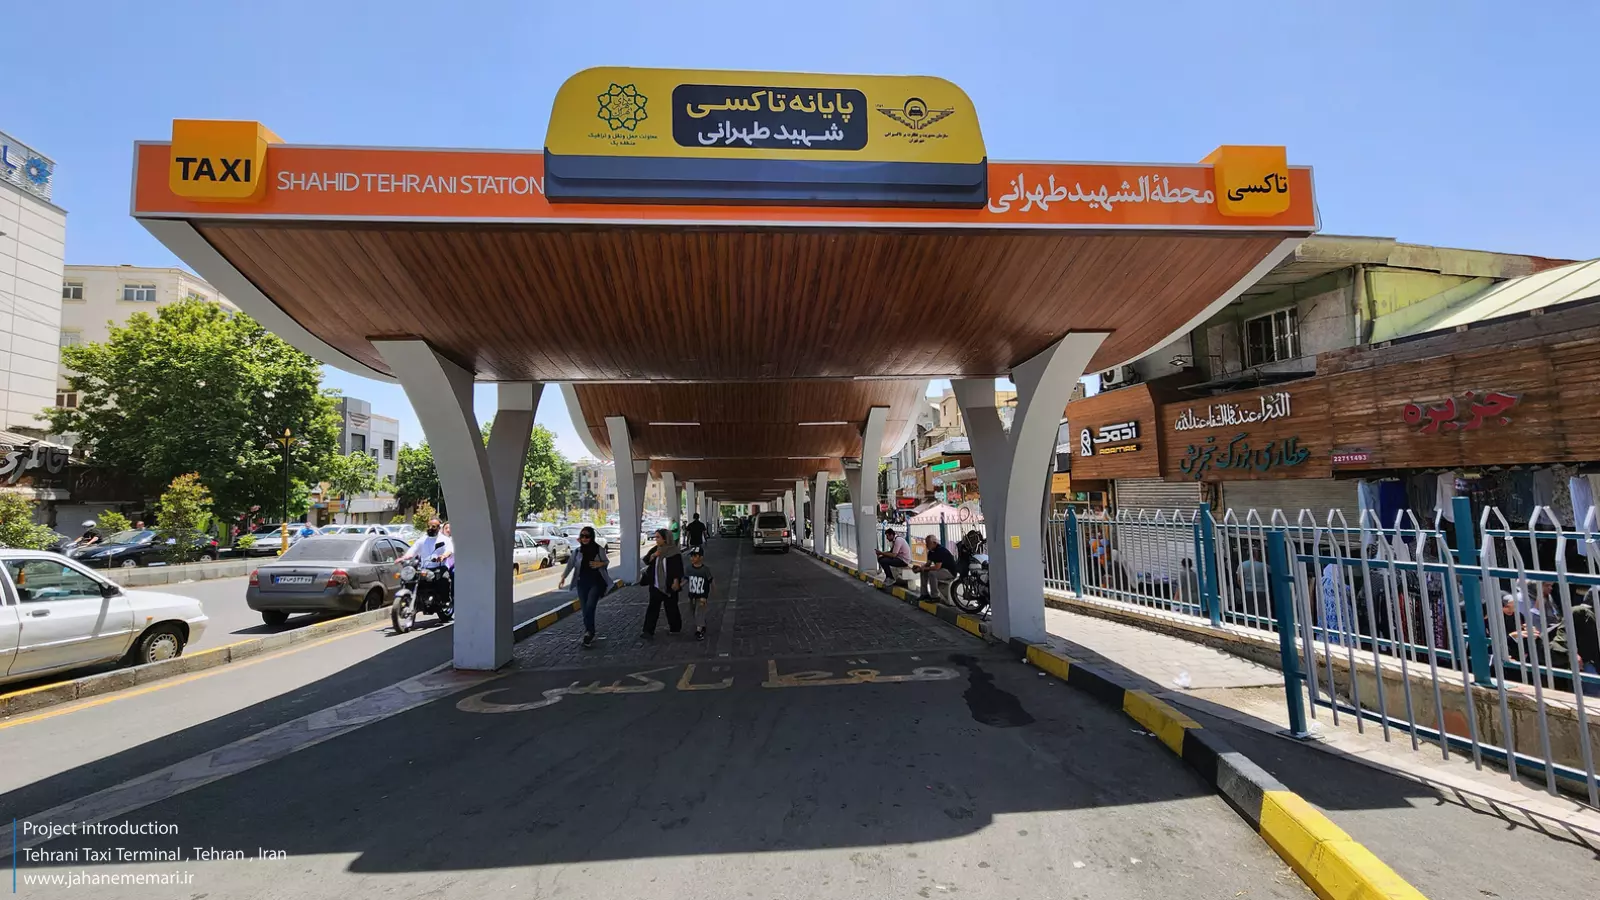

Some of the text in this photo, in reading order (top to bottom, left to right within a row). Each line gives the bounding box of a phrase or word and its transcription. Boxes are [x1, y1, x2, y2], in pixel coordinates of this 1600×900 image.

[686, 89, 854, 123] پایانه تاکسی
[697, 120, 844, 147] شهید طهرانی
[175, 157, 252, 183] TAXI
[277, 171, 545, 195] SHAHID TEHRANI STATION
[987, 172, 1068, 214] طهرانی
[1227, 173, 1288, 201] تاکسی
[1402, 390, 1519, 435] جزیره
[1093, 421, 1137, 444] آدمک
[1180, 431, 1311, 480] عطاری بزرگ تجریش
[1333, 454, 1367, 462] 22711493
[456, 664, 734, 714] تاکسی
